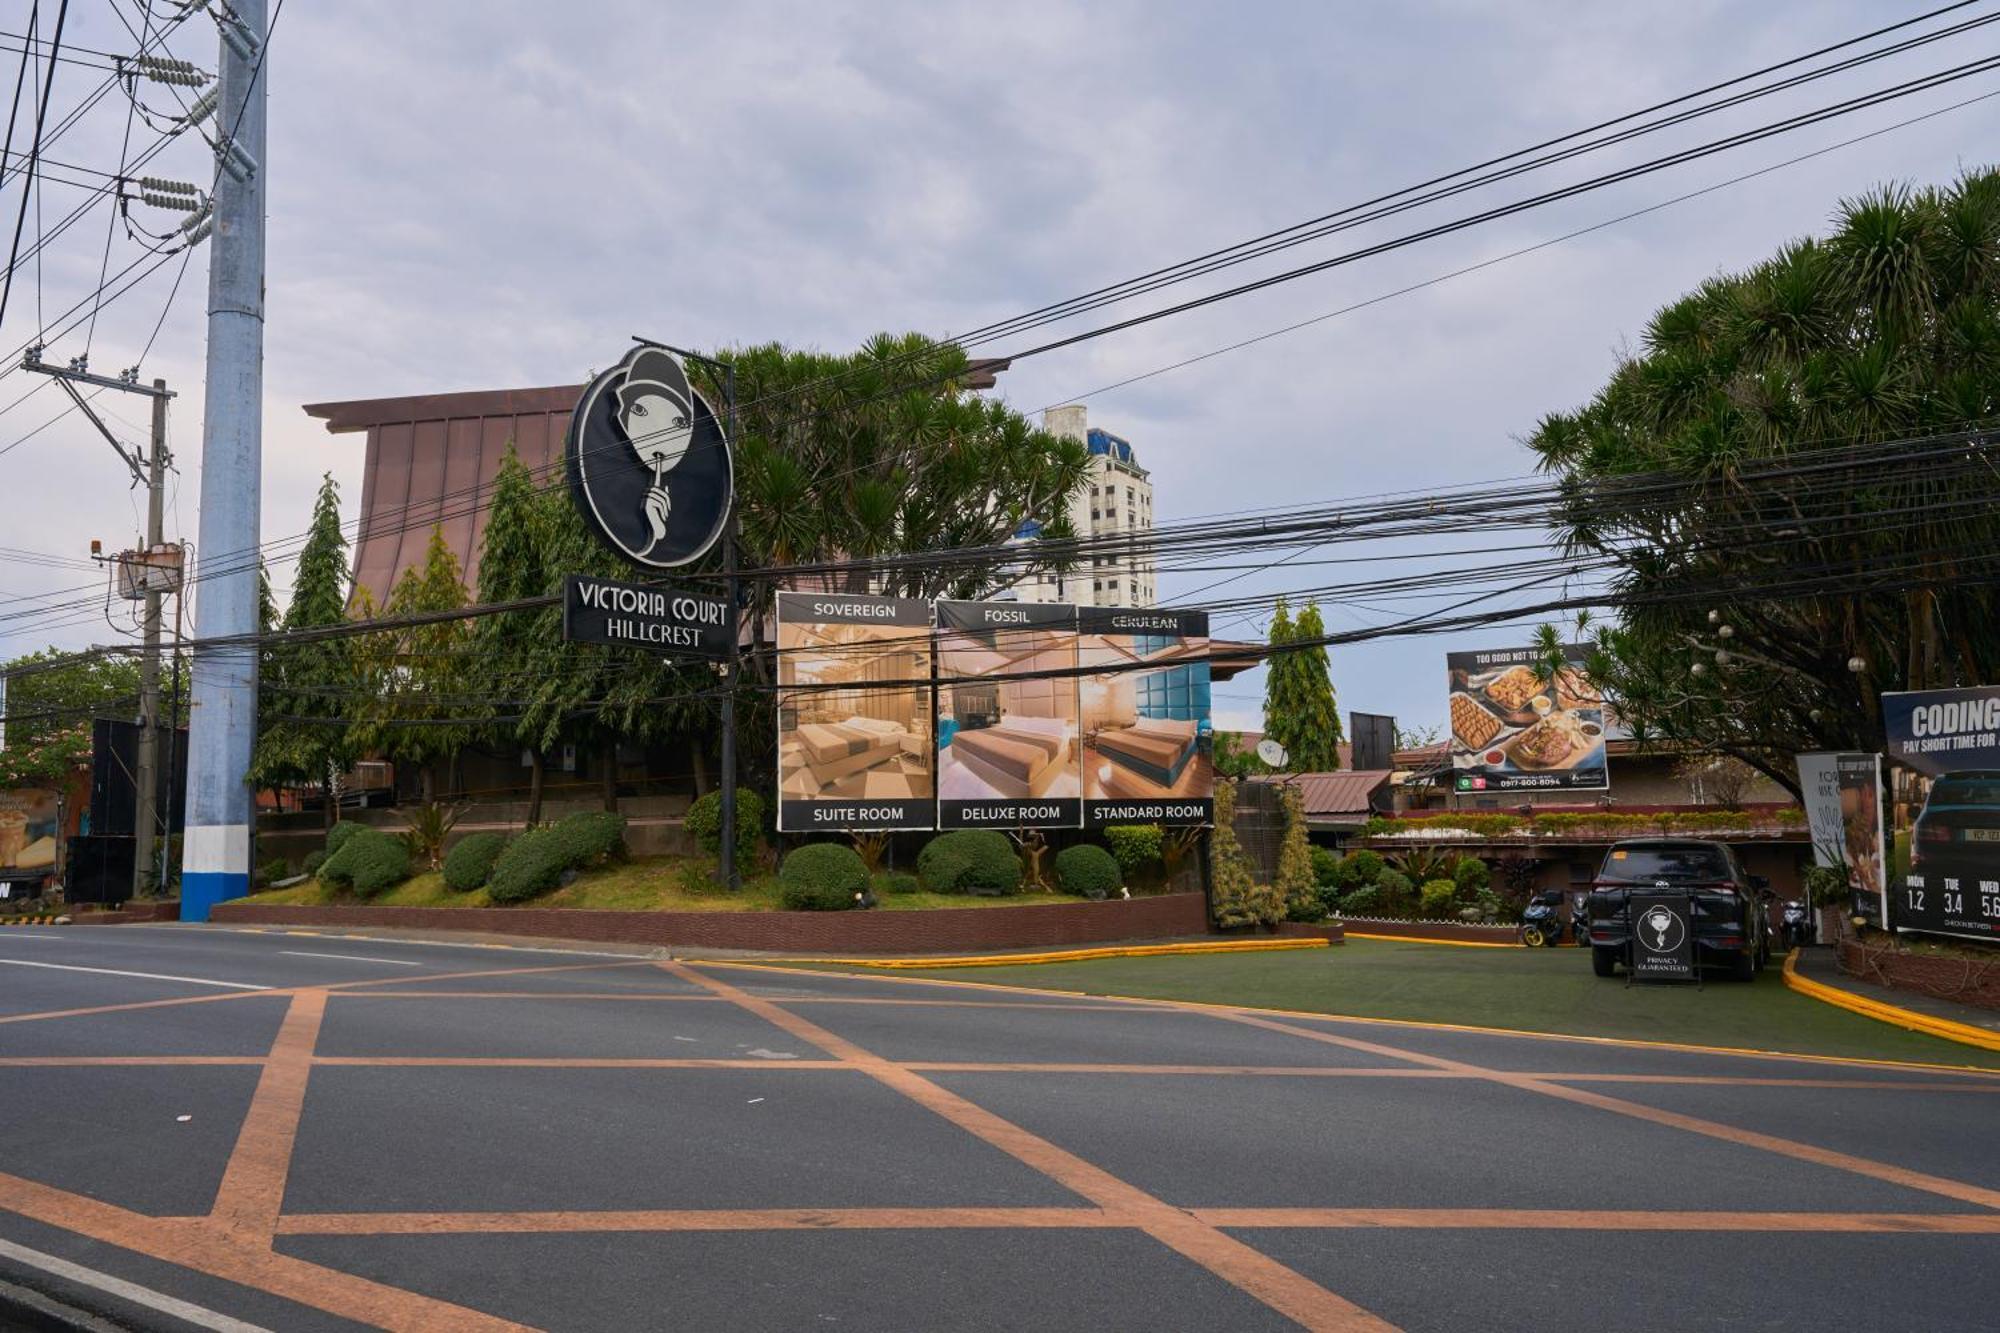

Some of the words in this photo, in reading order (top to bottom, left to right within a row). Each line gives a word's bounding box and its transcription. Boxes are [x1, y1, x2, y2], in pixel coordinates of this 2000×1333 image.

[578, 582, 665, 617] VICTORIA
[672, 597, 728, 626] COURT
[813, 603, 896, 617] SOVEREIGN
[984, 609, 1031, 623] FOSSIL
[1111, 615, 1178, 629] CERULEAN
[607, 618, 703, 647] HILLCREST
[1476, 655, 1490, 664] TOO
[1491, 652, 1511, 663] GOOD
[1512, 651, 1527, 661] NOT
[1528, 651, 1538, 660] TO
[1912, 698, 2000, 737] CODING
[1903, 740, 1920, 754] PAY
[1920, 737, 1952, 752] SHORT
[1953, 735, 1976, 750] TIME
[1976, 733, 1996, 747] FOR
[813, 808, 856, 821] SUITE
[859, 807, 904, 821] ROOM
[962, 808, 1016, 820] DELUXE
[1019, 807, 1060, 819] ROOM
[1094, 806, 1163, 819] STANDARD
[1166, 806, 1204, 818] ROOM
[1906, 875, 1925, 888] MON
[1943, 877, 1960, 890] TUE
[1979, 880, 2000, 893] WED
[1638, 964, 1688, 972] GUARANTEED
